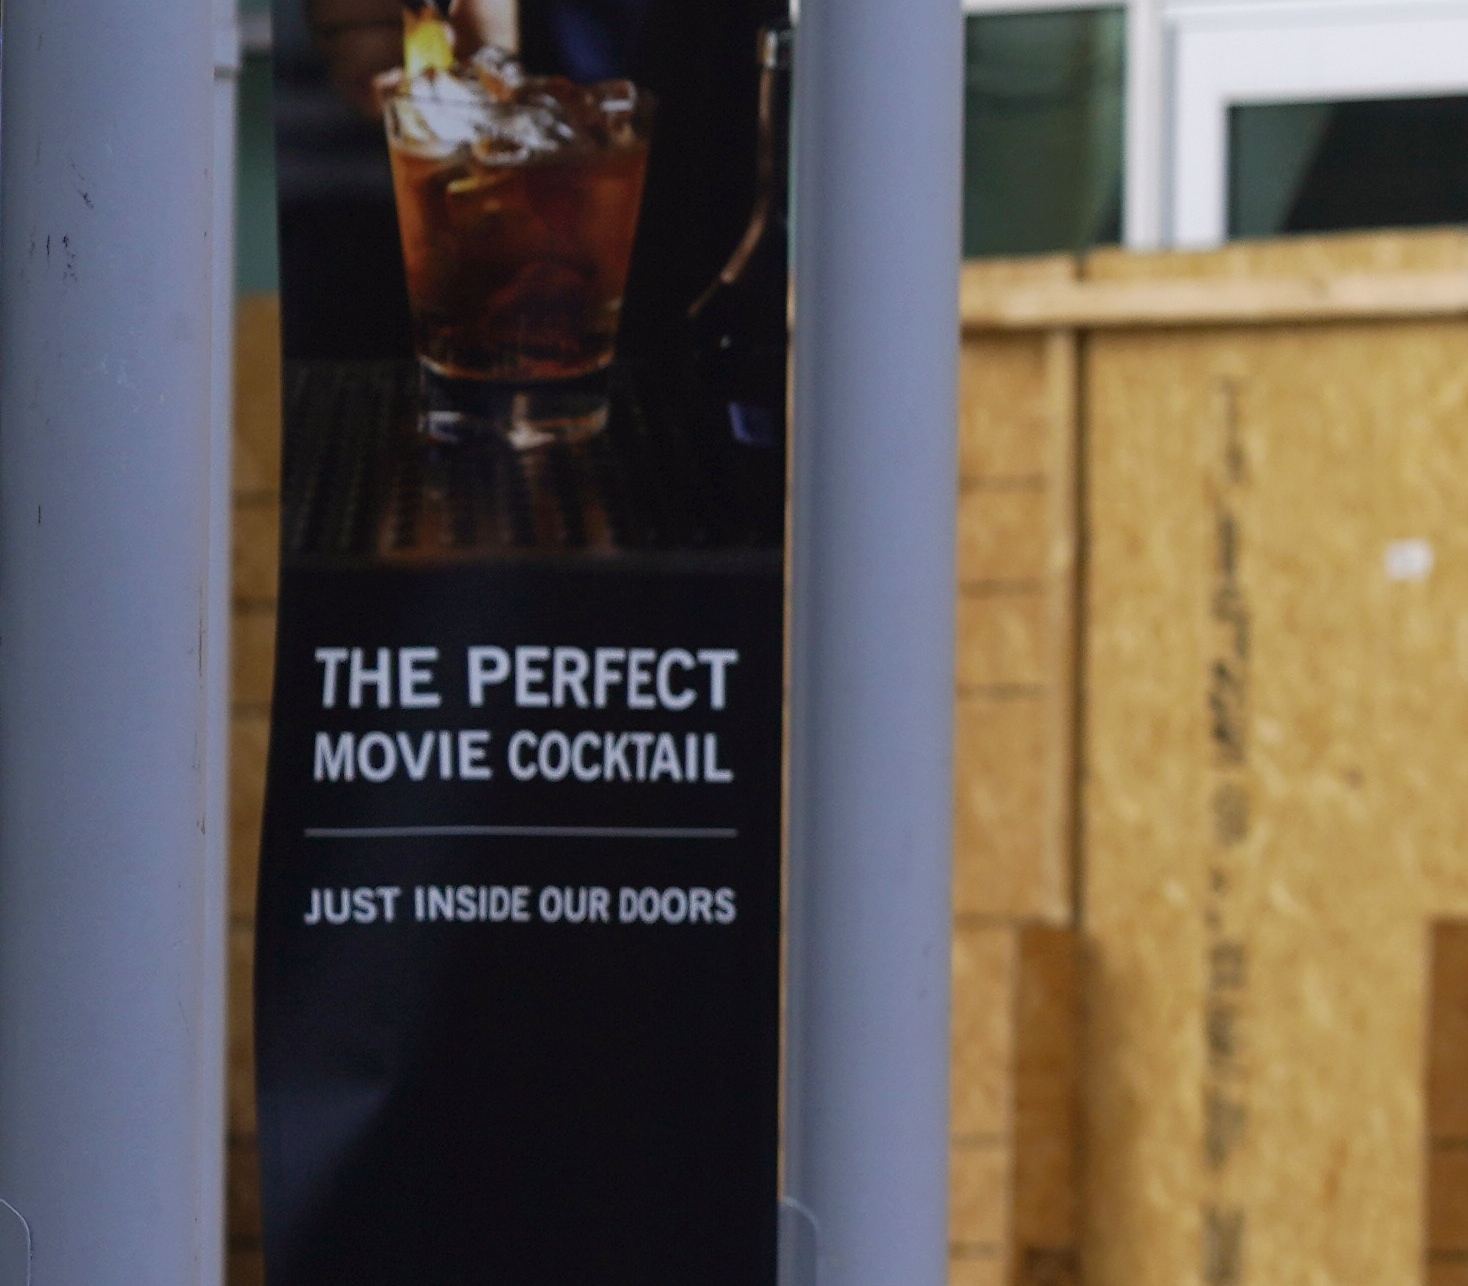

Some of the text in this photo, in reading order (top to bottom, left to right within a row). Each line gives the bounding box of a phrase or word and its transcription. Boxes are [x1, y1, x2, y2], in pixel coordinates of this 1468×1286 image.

[315, 646, 739, 711] THE PERFECT
[314, 730, 734, 783] MOVIE COCKTAIL
[303, 885, 737, 924] JUST INSIDE OUR DOORS
